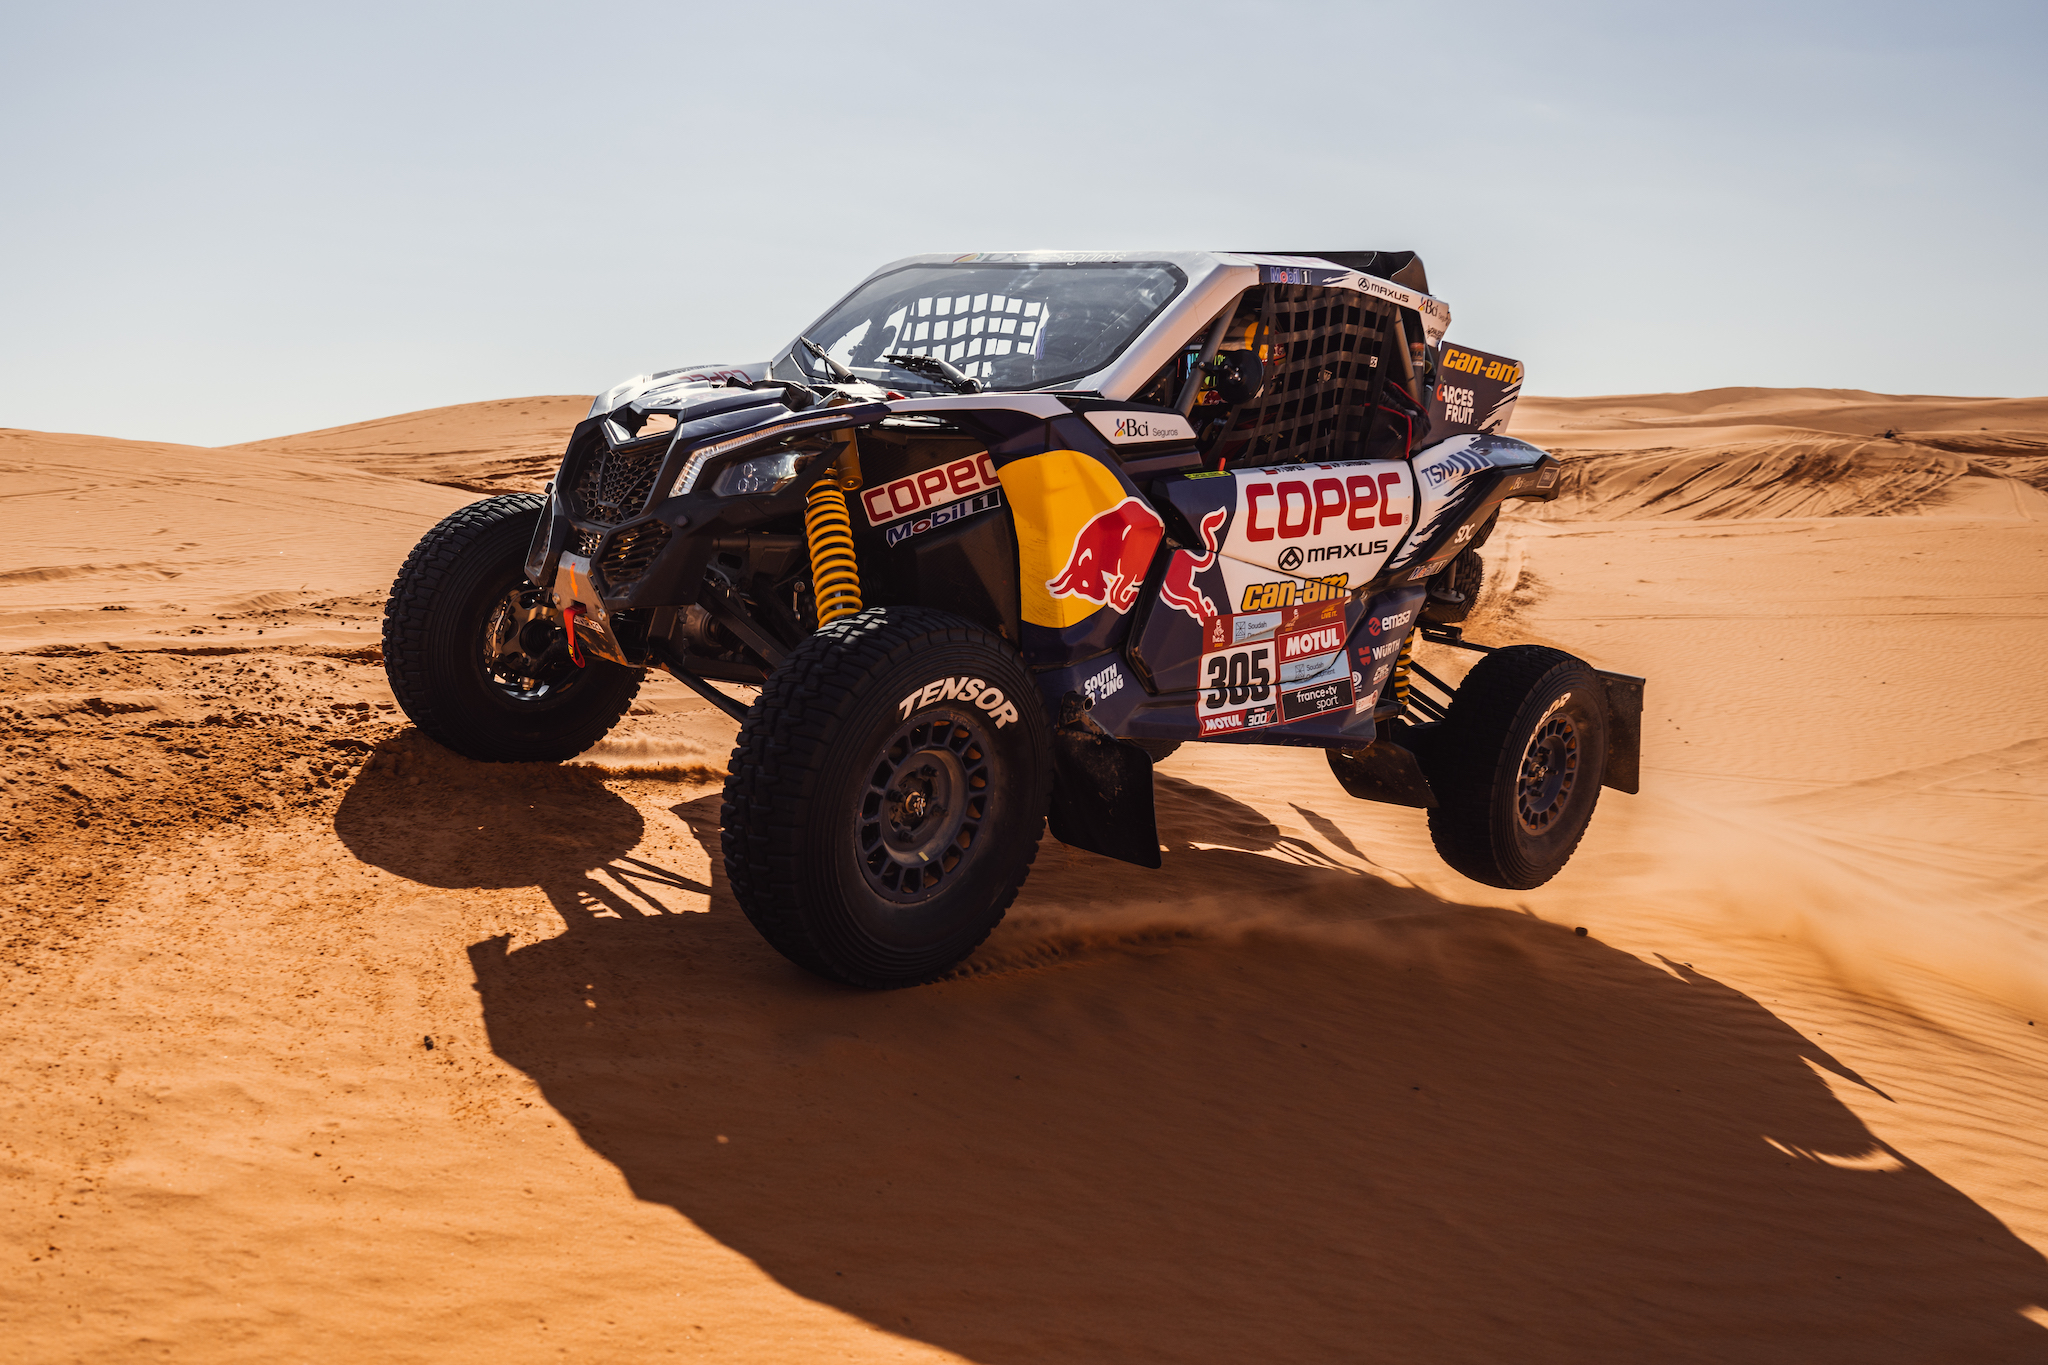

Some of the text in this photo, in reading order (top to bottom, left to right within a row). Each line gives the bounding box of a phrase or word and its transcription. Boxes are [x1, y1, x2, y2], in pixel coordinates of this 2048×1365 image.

[1270, 267, 1310, 285] Mobil 1
[1371, 283, 1410, 303] MAXUS
[1443, 349, 1520, 384] can-am
[1445, 404, 1475, 425] FRUIT
[1126, 418, 1178, 438] Bci Seguros
[887, 501, 967, 548] Mobil
[1308, 540, 1388, 563] MAXUS
[1241, 572, 1349, 612] can-am
[1248, 621, 1267, 630] Soudah
[1382, 609, 1412, 631] emasa
[1286, 627, 1340, 658] MOTUL
[1306, 662, 1324, 671] Soudah
[1084, 662, 1117, 695] SOUTH
[1206, 648, 1270, 710] 305
[898, 676, 1019, 730] TENSOR
[1316, 696, 1338, 711] sport
[1205, 709, 1276, 731] MOTUL 300V
